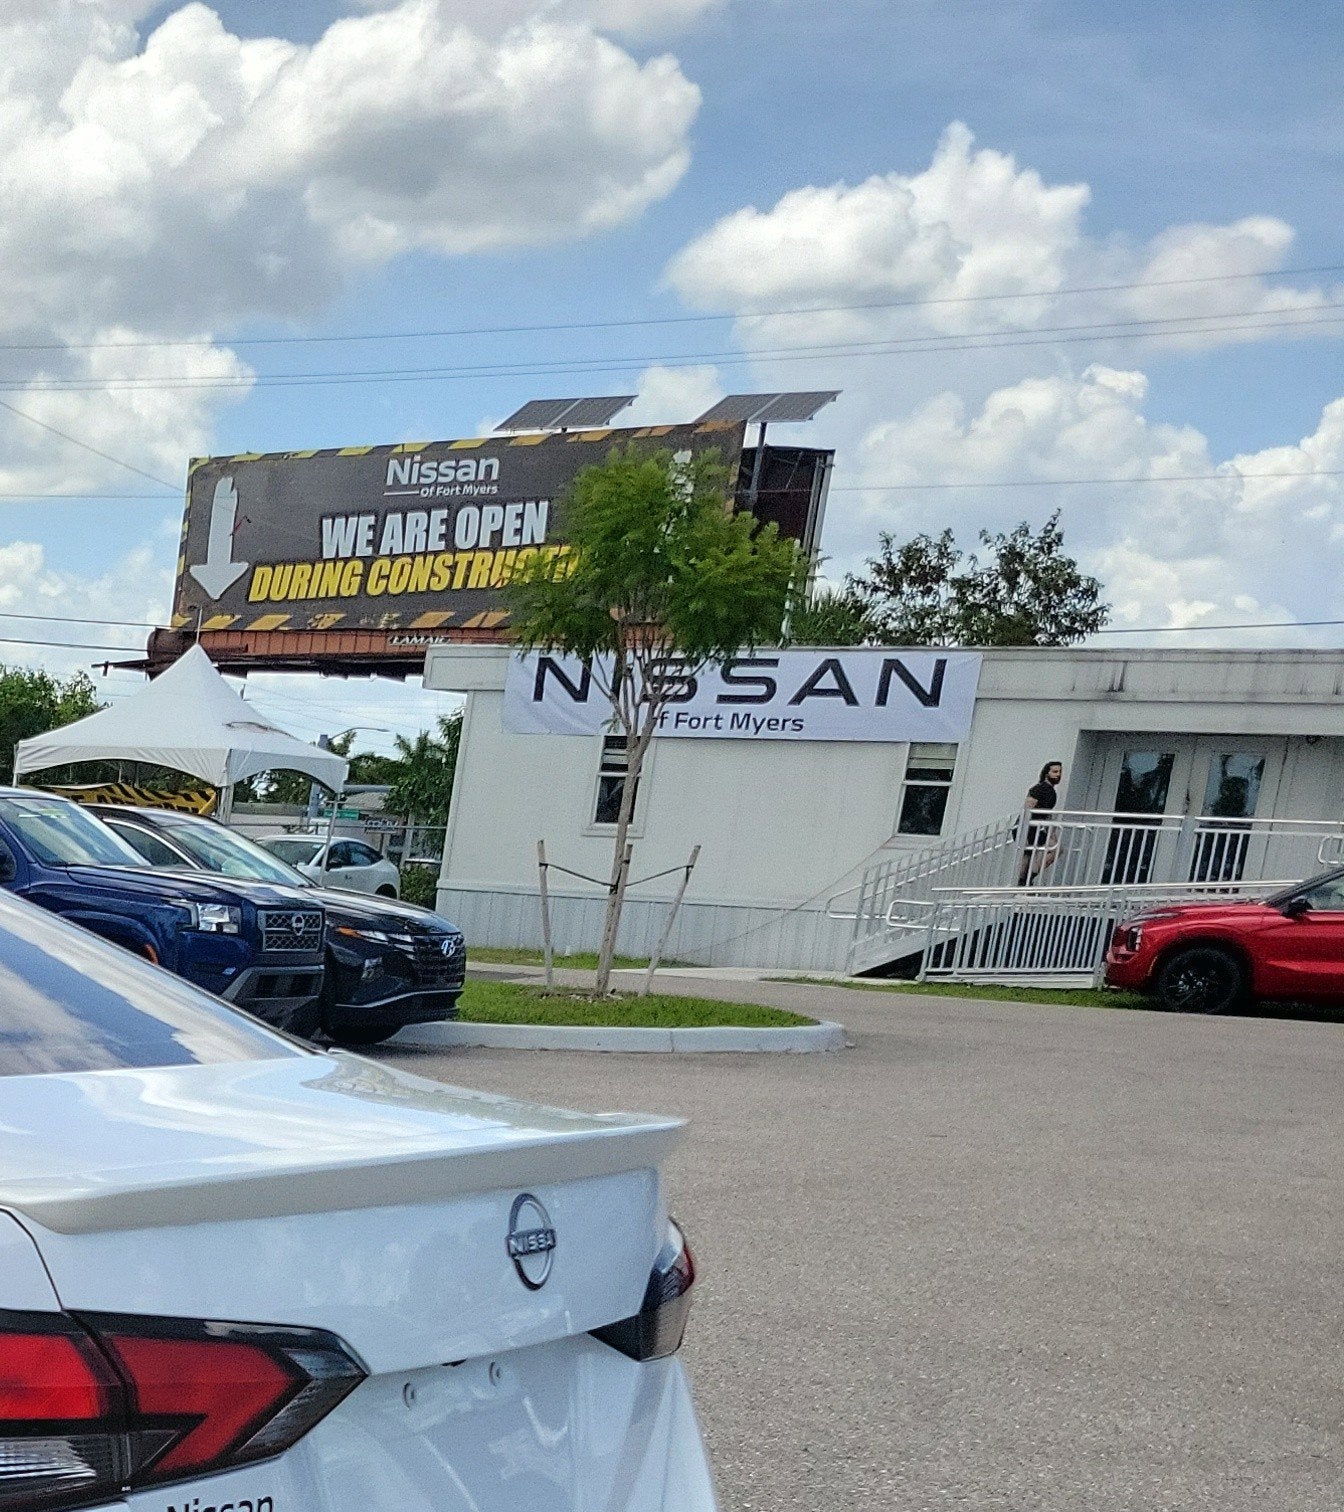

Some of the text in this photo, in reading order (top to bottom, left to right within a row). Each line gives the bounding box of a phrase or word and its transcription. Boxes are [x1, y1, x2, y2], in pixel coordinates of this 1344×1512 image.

[386, 455, 500, 486] Nissan
[436, 485, 461, 497] Fort
[462, 483, 498, 496] Myers
[321, 500, 550, 560] WE ARE OPEN
[248, 557, 364, 602] DURING
[532, 656, 948, 708] NISSAN
[674, 711, 723, 730] Fort
[730, 712, 805, 736] Myers
[509, 1233, 554, 1252] NISSA
